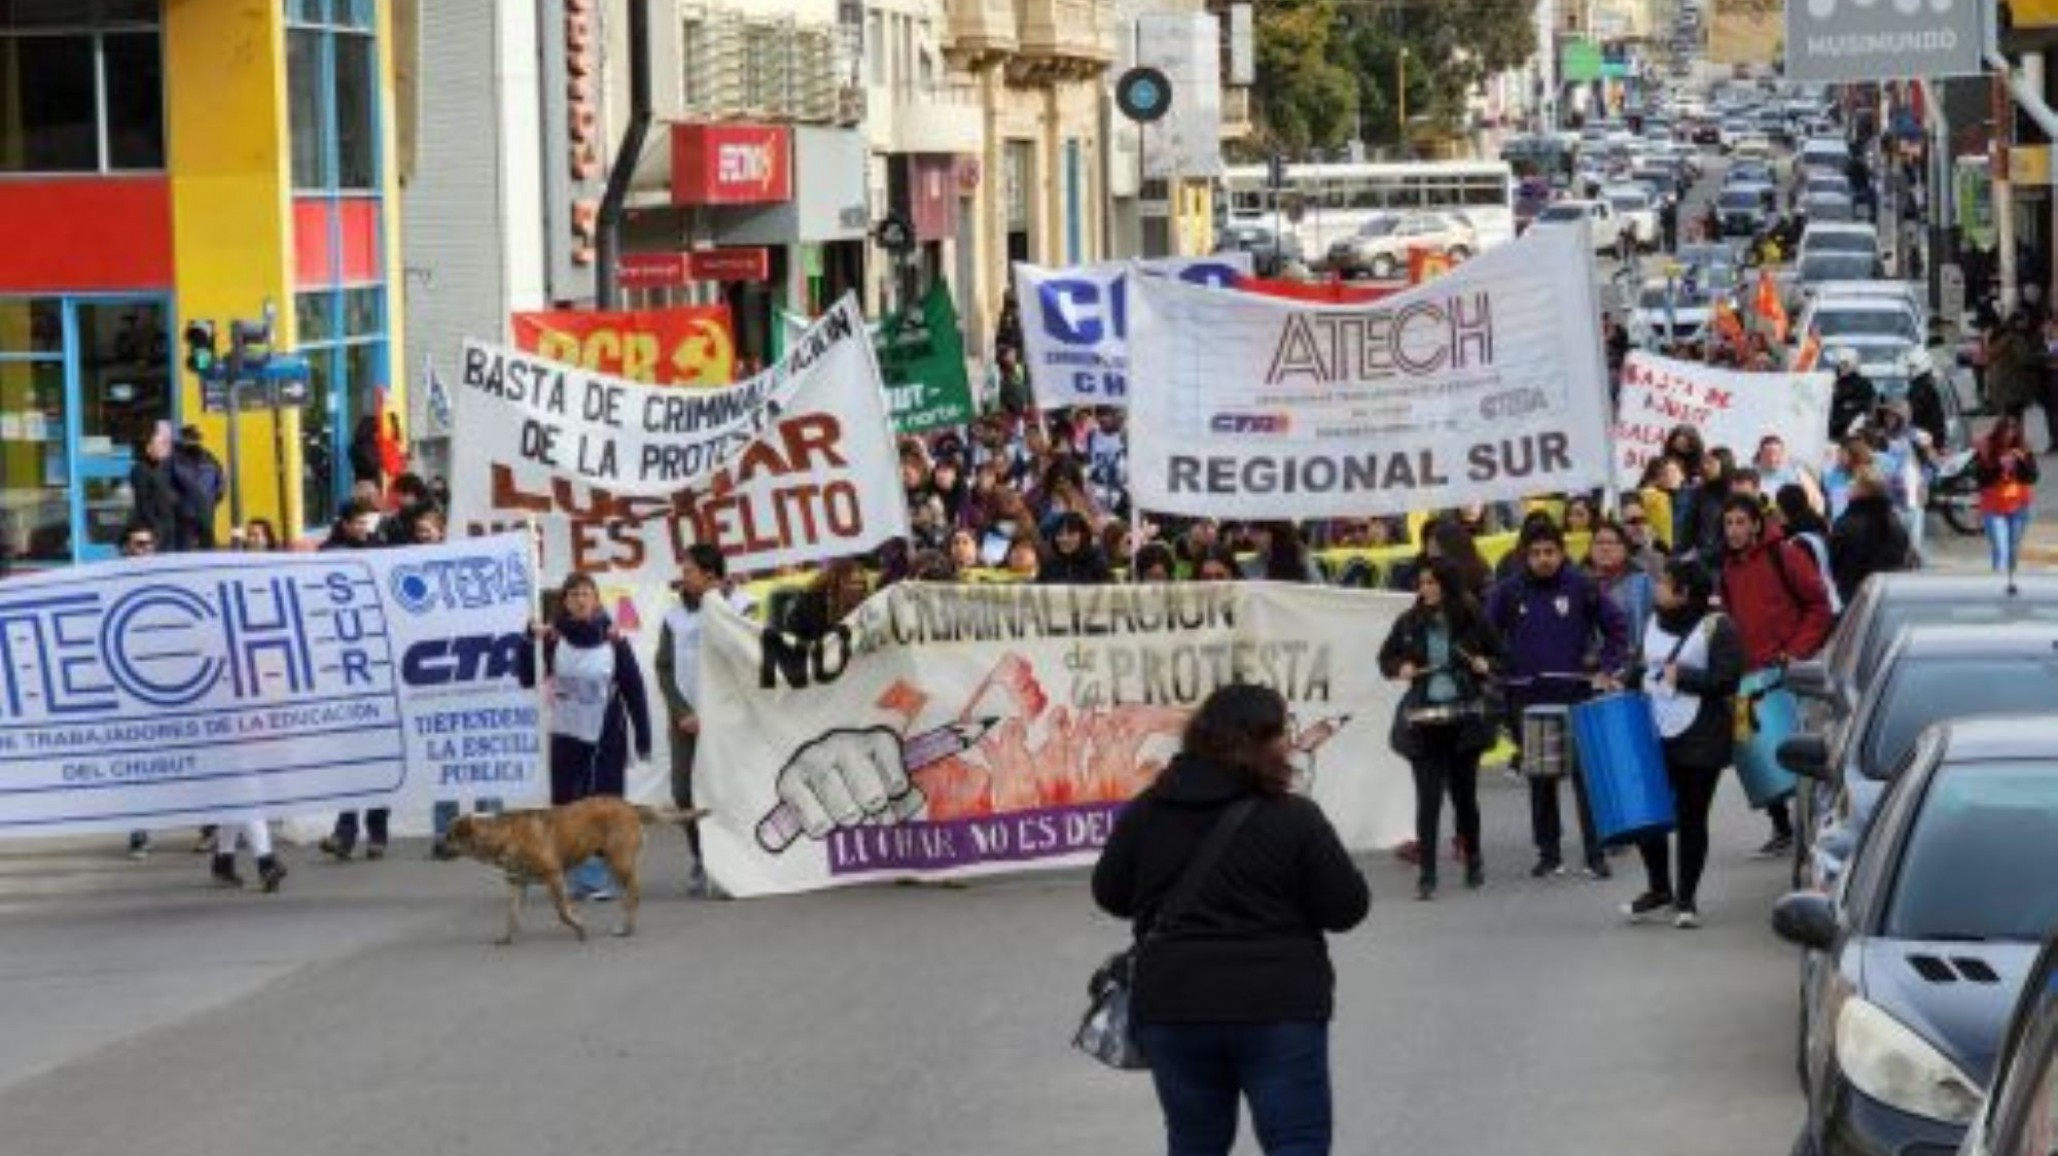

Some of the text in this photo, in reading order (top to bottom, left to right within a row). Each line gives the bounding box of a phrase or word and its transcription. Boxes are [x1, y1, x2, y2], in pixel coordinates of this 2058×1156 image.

[1264, 292, 1494, 385] ATECH
[463, 346, 565, 416] BASTA
[583, 379, 625, 427] DE
[490, 412, 849, 524] LUAR
[521, 418, 561, 467] DE
[578, 433, 619, 479] LA
[1167, 431, 1572, 493] REGIONAL SUR
[571, 516, 645, 575] ES
[667, 480, 863, 565] DELITO
[760, 622, 853, 690] NO
[1107, 638, 1333, 705] PROTESTA
[239, 715, 263, 732] LA
[969, 821, 1009, 854] NO
[1018, 814, 1058, 851] ES
